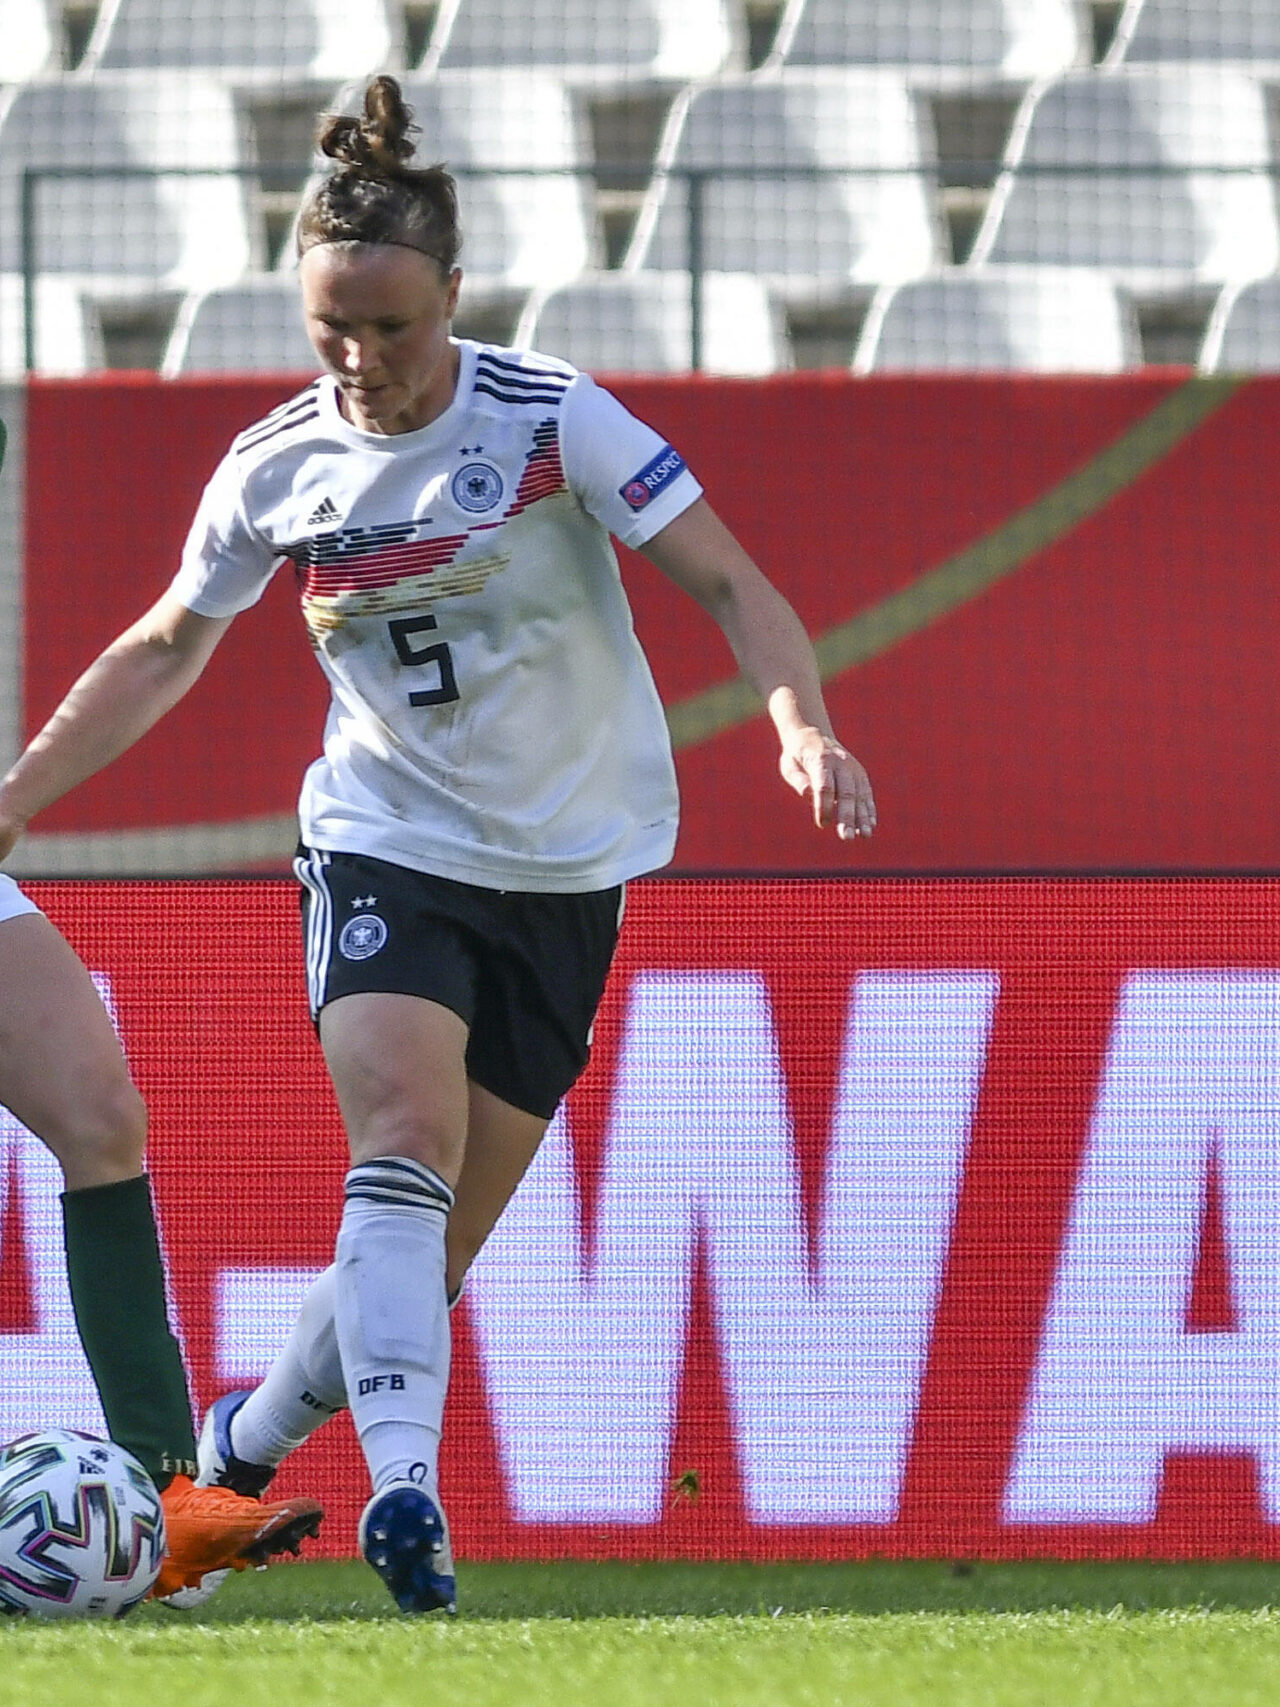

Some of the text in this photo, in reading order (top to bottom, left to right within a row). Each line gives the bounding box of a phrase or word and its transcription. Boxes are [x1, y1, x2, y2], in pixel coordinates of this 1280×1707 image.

[644, 450, 681, 490] RESPECT
[387, 613, 461, 708] 5
[358, 1373, 406, 1397] DFB
